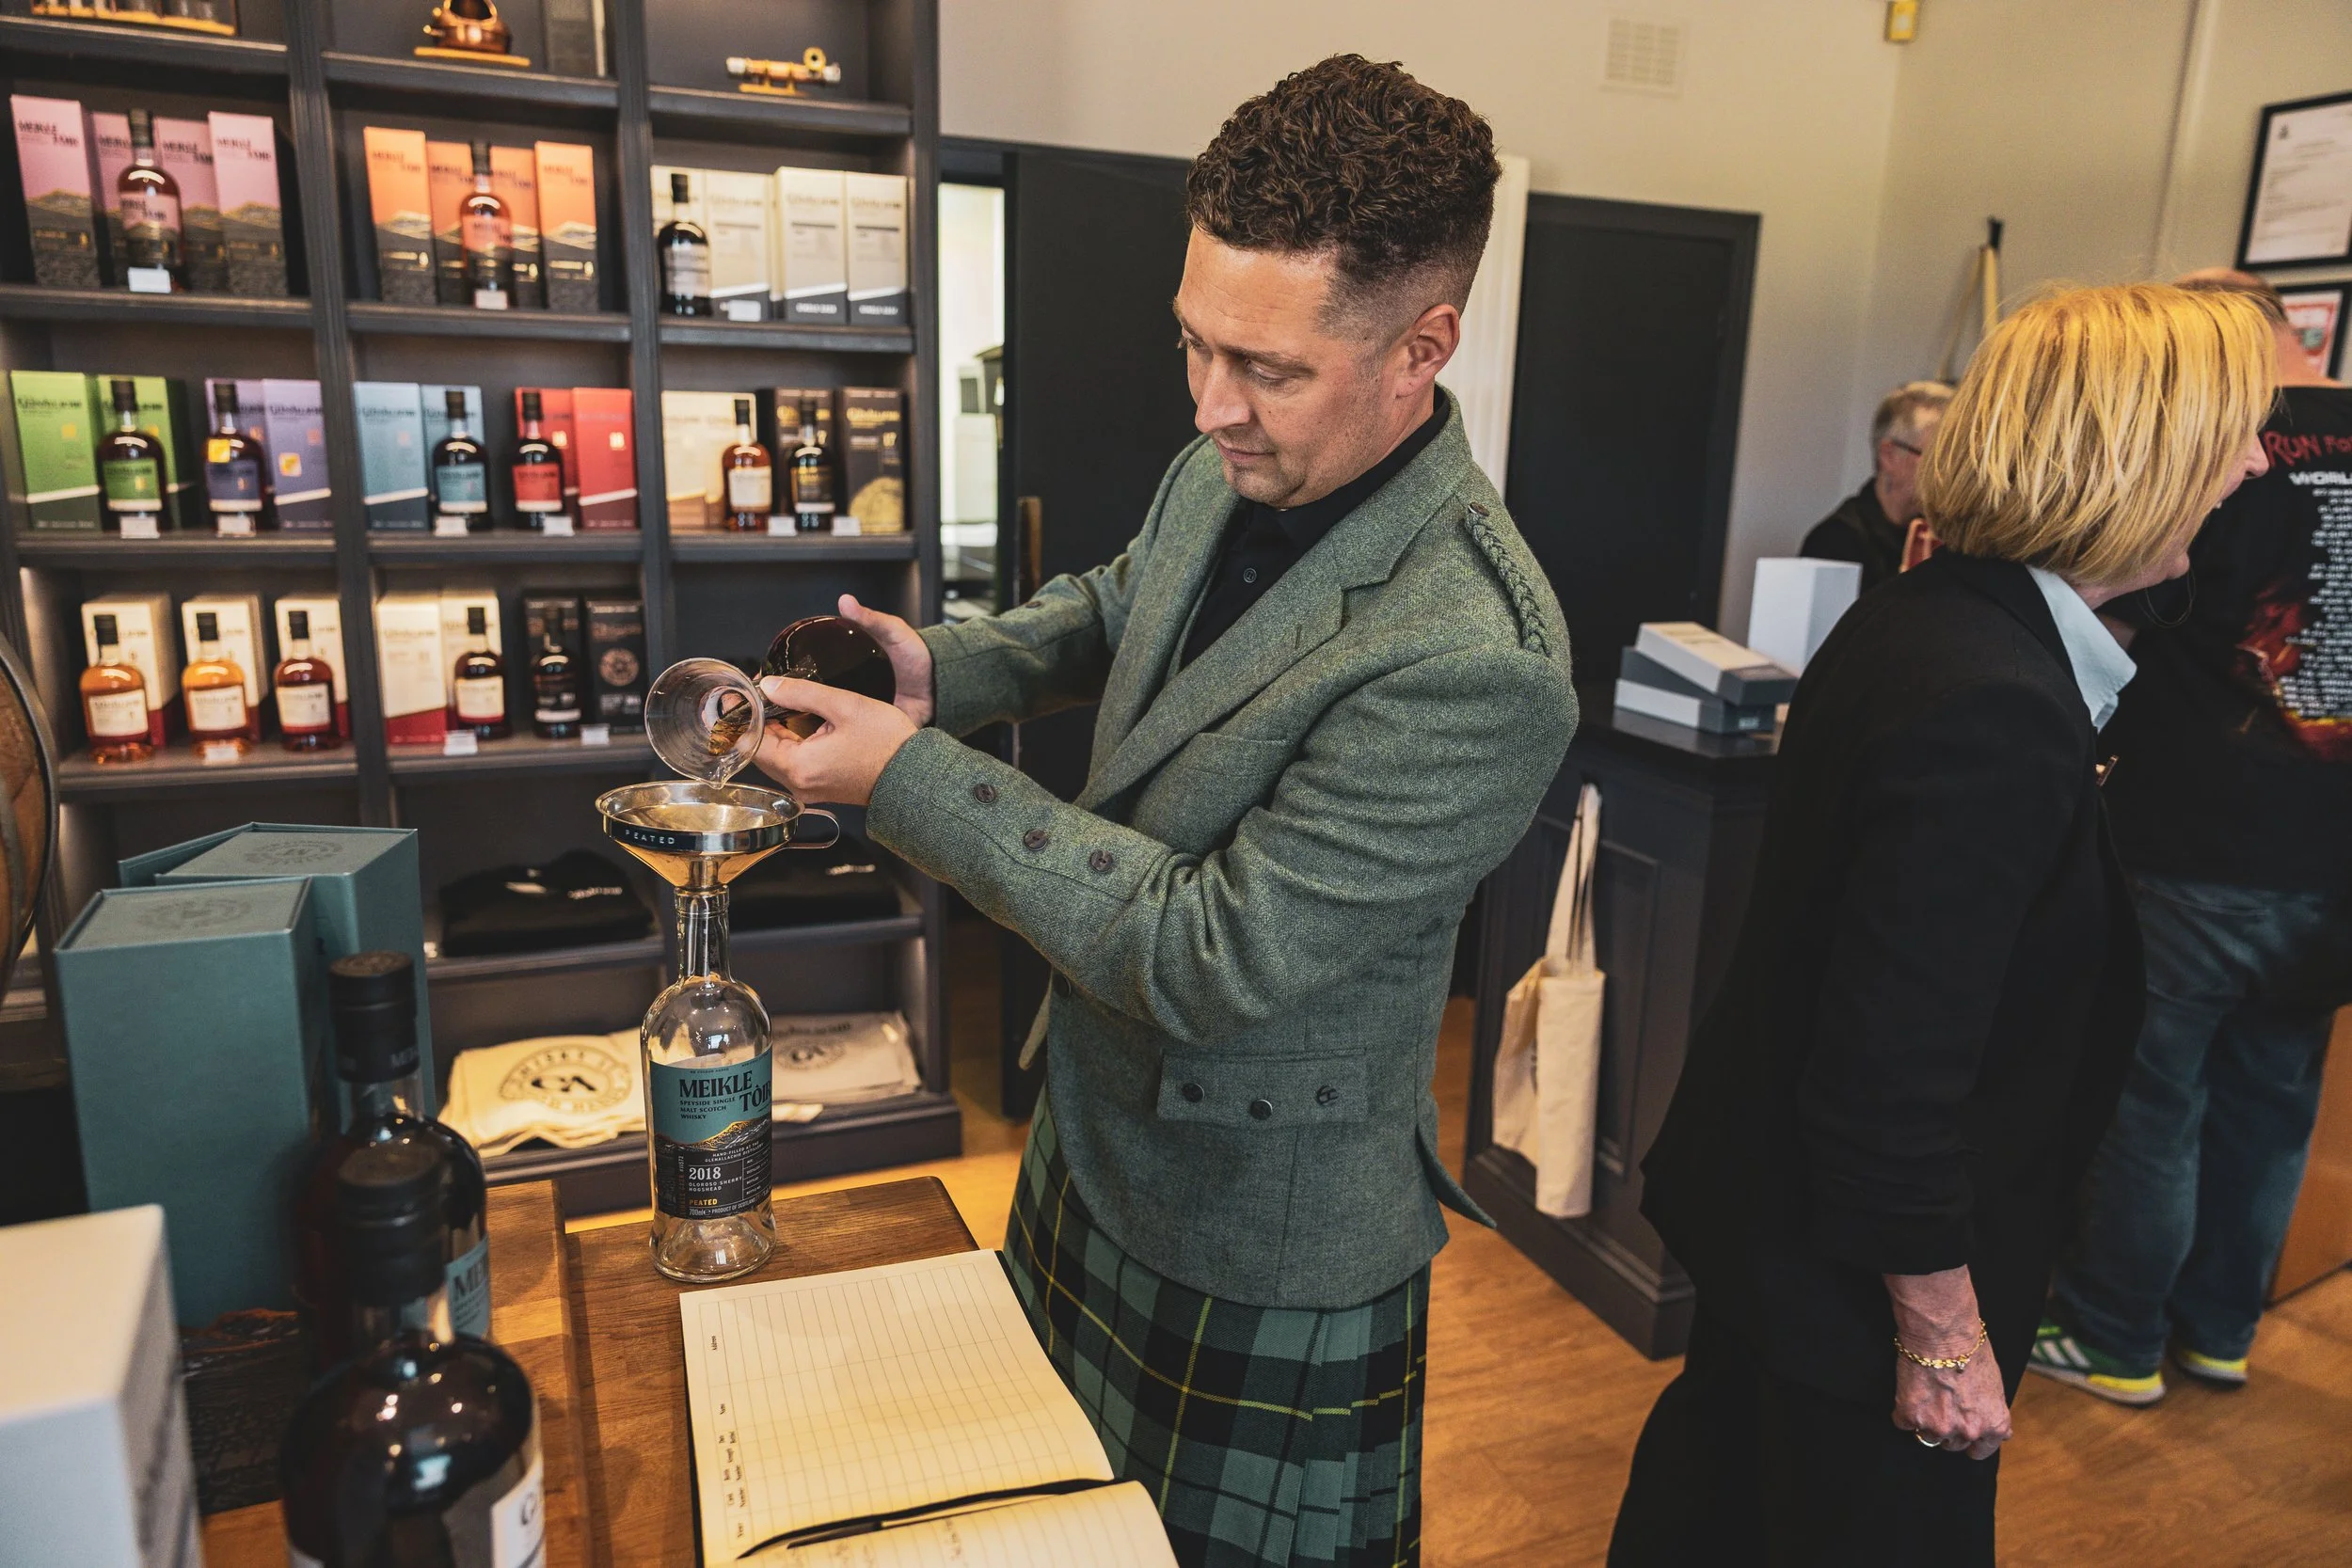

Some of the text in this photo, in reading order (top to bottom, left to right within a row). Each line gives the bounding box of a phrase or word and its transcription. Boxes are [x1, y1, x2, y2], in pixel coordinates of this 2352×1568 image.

[2265, 431, 2321, 467] RUN
[2289, 471, 2352, 484] WORL
[625, 829, 675, 845] PEATED
[679, 1069, 753, 1099] MEIKLE
[713, 1096, 736, 1105] SINGLE
[705, 1152, 741, 1163] GLENALLACHIE
[712, 1147, 745, 1158] HAND-FILLED
[689, 1166, 722, 1180] 2018
[719, 1176, 742, 1185] SHERRY
[711, 1206, 732, 1214] PRODUCT
